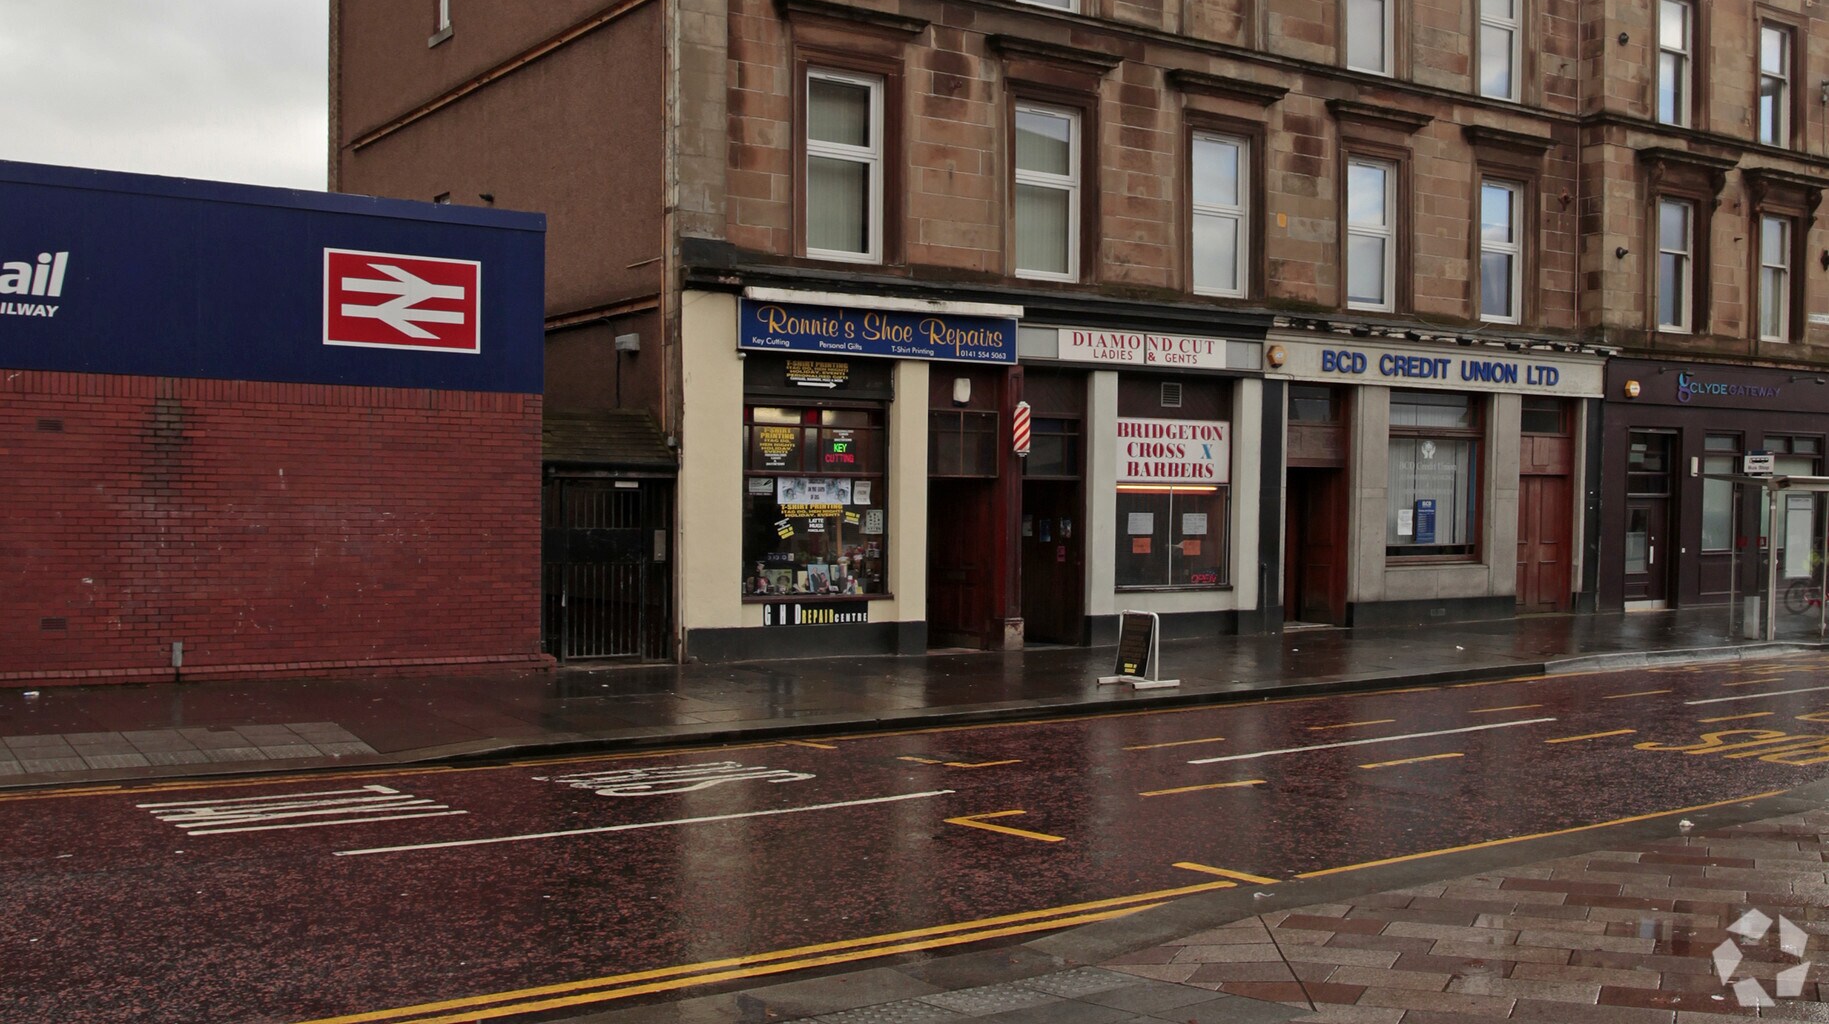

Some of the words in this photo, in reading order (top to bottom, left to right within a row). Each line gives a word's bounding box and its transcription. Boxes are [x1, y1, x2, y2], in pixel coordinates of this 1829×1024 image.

[757, 305, 855, 338] Ronnie's
[862, 312, 913, 343] Shoe
[919, 318, 1004, 357] Repairs
[752, 336, 764, 346] Key
[766, 337, 790, 347] Cutting
[819, 340, 846, 350] Personal
[847, 342, 862, 351] Gifts
[891, 345, 911, 354] T-Shirt
[911, 346, 934, 356] Printing
[1072, 331, 1173, 351] DIAMOND
[1179, 338, 1216, 354] CUT
[960, 350, 976, 358] 0141
[978, 350, 990, 358] 554
[991, 351, 1006, 359] 5063
[1093, 348, 1133, 361] LADIES
[1147, 352, 1156, 362] &
[1165, 353, 1198, 364] GENTS
[1322, 350, 1367, 373] BCD
[1379, 353, 1451, 379] CREDIT
[1461, 360, 1518, 383] UNION
[1527, 365, 1559, 386] LTD
[1690, 382, 1727, 395] CLYDE
[1729, 384, 1781, 397] GATEWAY
[760, 432, 795, 440] PRINTING
[1117, 422, 1223, 441] BRIDGETON
[833, 443, 848, 453] KEY
[1127, 442, 1186, 459] CROSS
[825, 453, 855, 463] CUTTING
[1126, 461, 1215, 478] BARBERS
[1191, 573, 1217, 584] OPEN
[801, 609, 834, 624] REPAIR
[834, 612, 868, 623] CENTRE
